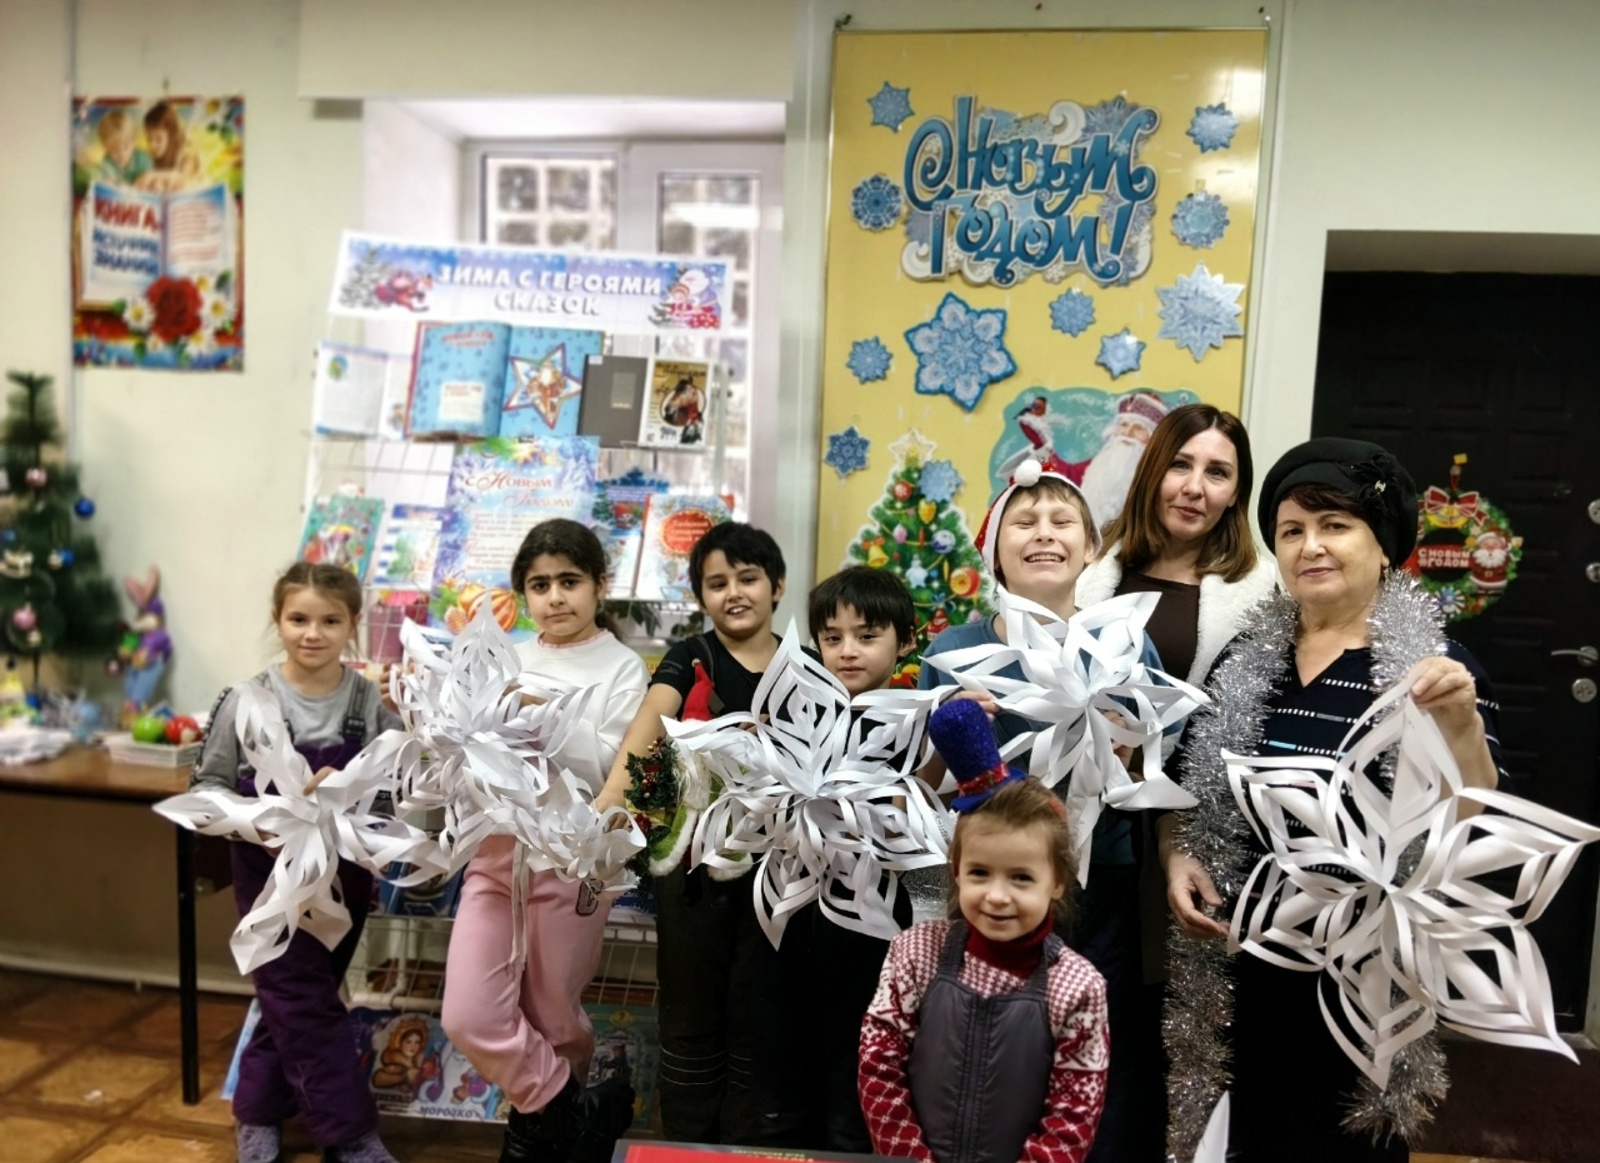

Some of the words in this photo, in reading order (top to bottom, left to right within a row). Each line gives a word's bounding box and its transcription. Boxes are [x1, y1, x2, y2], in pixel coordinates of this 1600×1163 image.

[904, 118, 954, 212] С
[437, 264, 509, 287] ЗИМА
[515, 269, 534, 289] С
[538, 271, 662, 297] ГЕРОЯМИ
[494, 291, 600, 316] СКАЗОК
